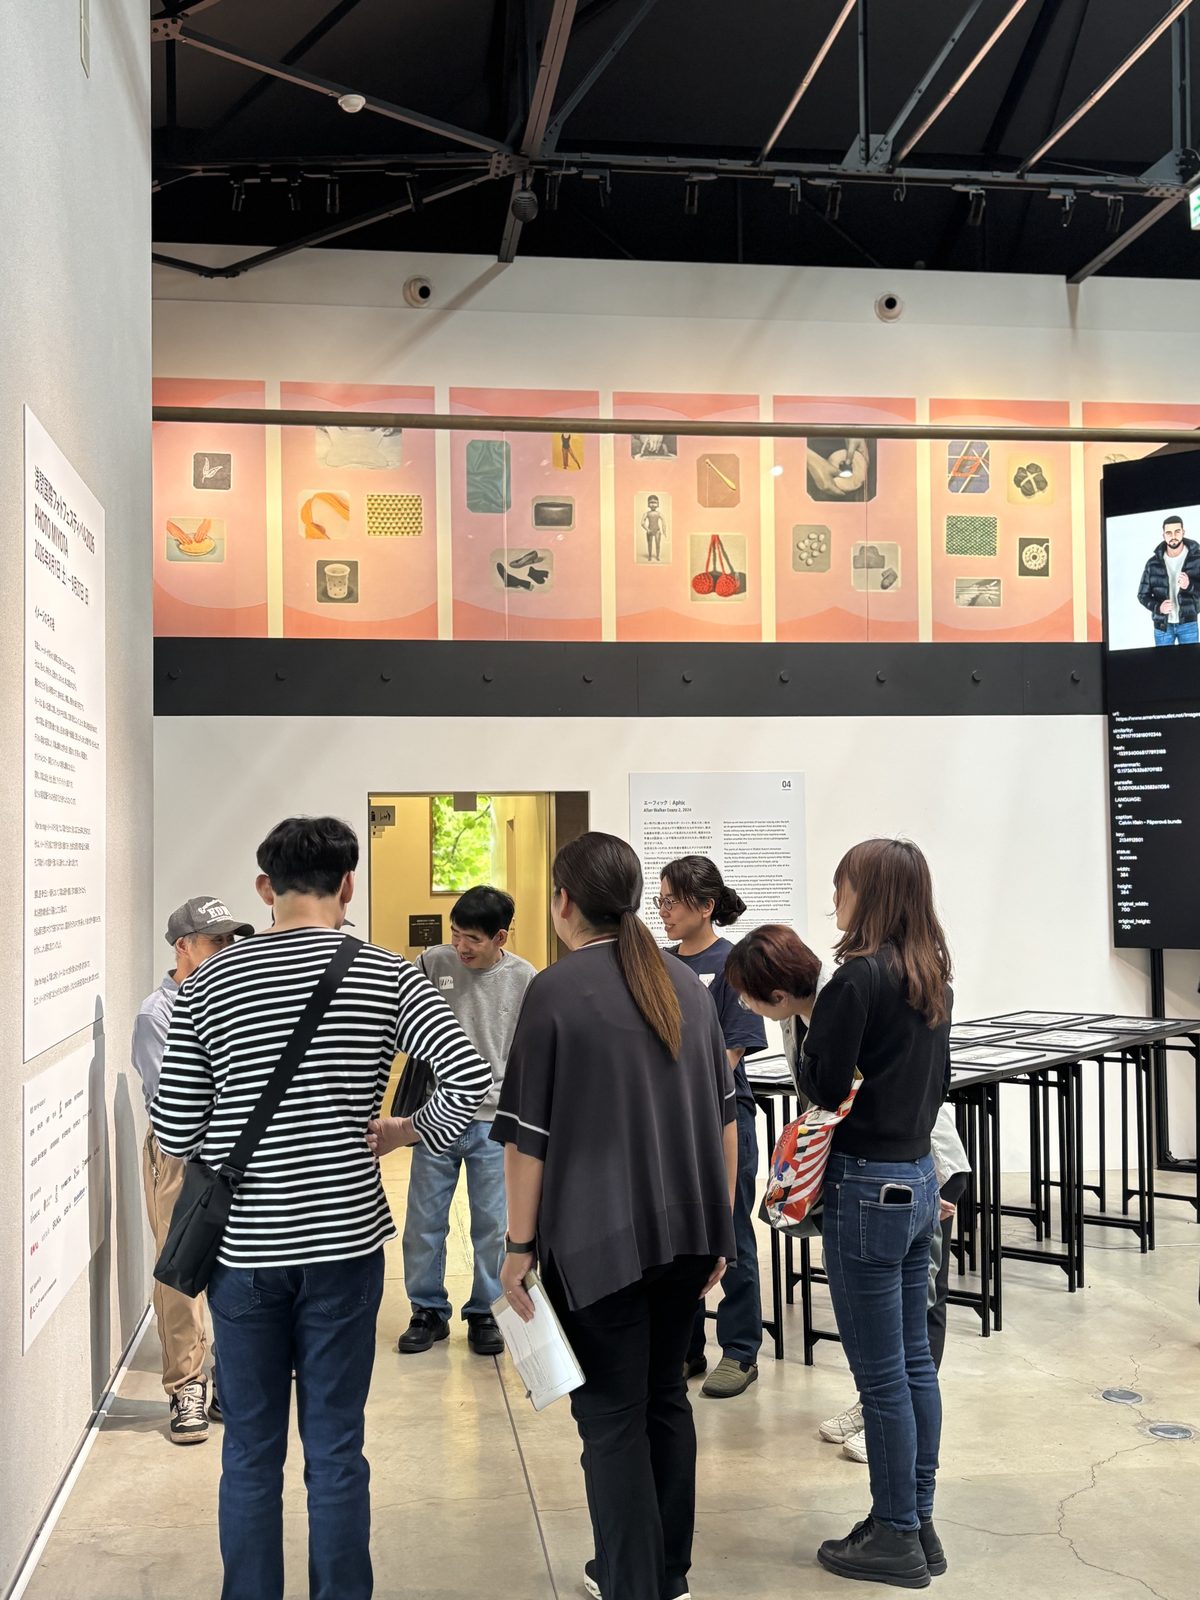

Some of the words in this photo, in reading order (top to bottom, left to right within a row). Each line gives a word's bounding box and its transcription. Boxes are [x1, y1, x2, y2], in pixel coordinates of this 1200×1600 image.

[34, 503, 50, 540] PHOTO
[51, 521, 69, 559] MIYOTA
[782, 780, 792, 788] 04
